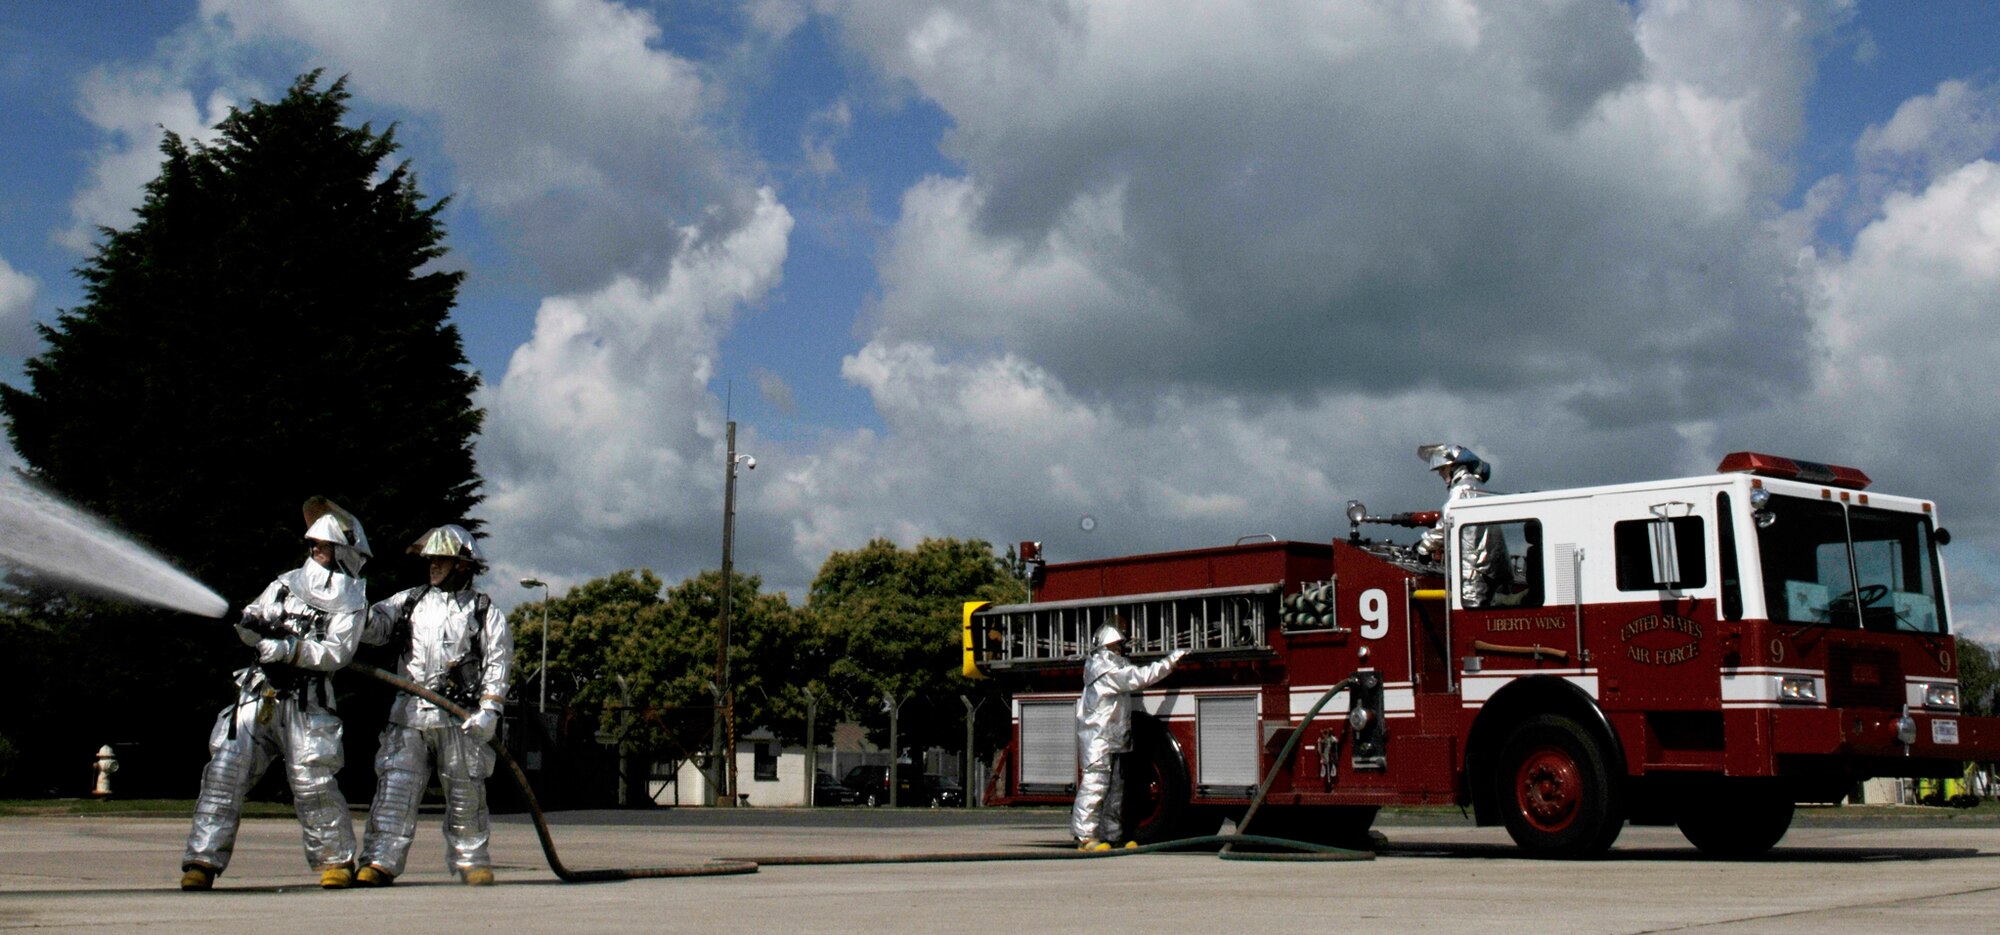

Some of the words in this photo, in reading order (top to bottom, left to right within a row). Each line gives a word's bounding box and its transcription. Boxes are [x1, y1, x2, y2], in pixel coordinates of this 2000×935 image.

[1359, 588, 1389, 640] 9
[1487, 617, 1532, 631] LIBERTY
[1535, 616, 1566, 629] WING
[1621, 615, 1659, 641] UNITED
[1663, 614, 1702, 639] STATES
[1627, 645, 1650, 663] AIR
[1655, 641, 1698, 664] FORCE
[1770, 638, 1784, 663] 9
[1939, 650, 1951, 673] 9
